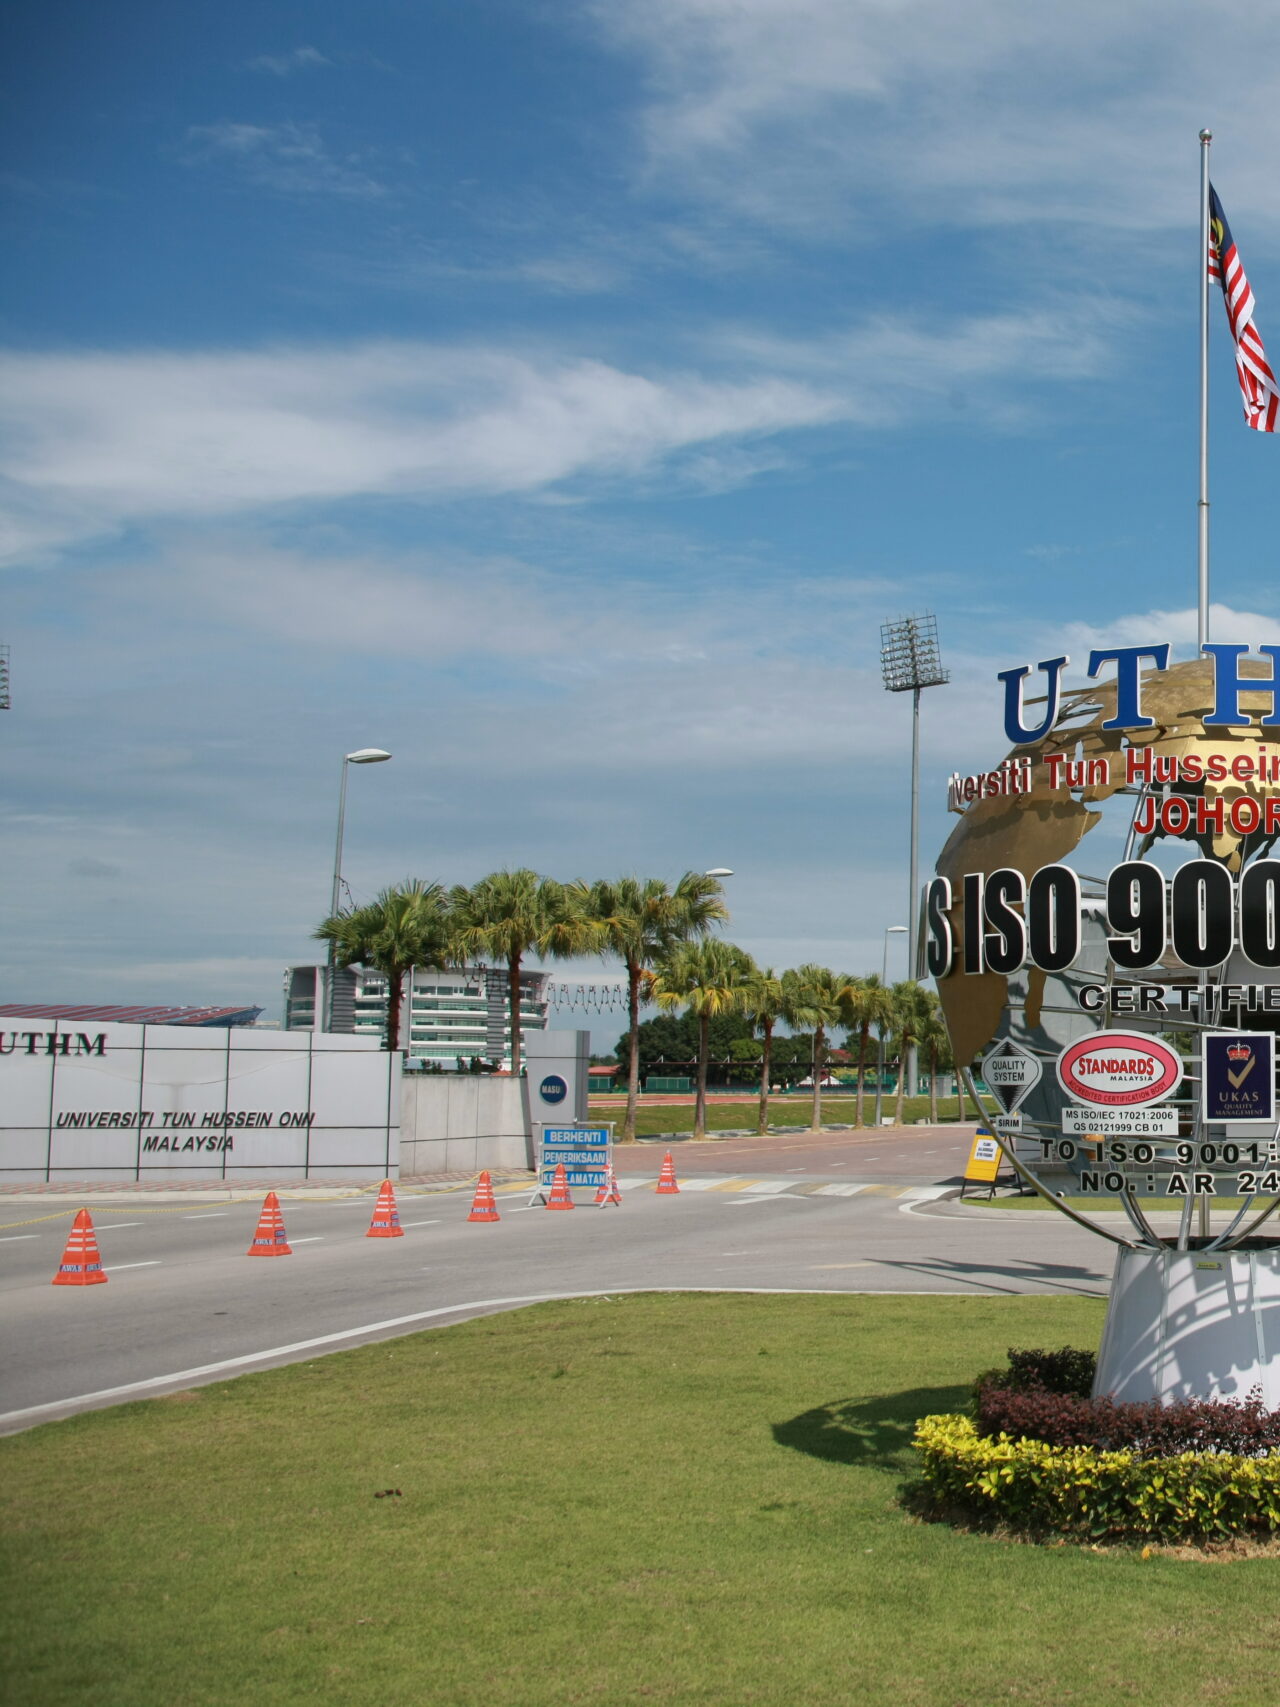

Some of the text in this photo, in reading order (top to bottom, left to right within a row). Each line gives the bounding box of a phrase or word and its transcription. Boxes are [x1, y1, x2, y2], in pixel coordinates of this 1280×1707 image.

[1043, 753, 1109, 790] Tun
[964, 864, 1081, 975] ISO
[0, 1032, 107, 1056] UTHM
[992, 1060, 1026, 1070] QUALITY
[1078, 1057, 1154, 1076] STANDARDS
[993, 1071, 1025, 1082] SYSTEM
[1068, 1080, 1167, 1102] ACCREDITED CERTIFICATION BODY
[1219, 1091, 1260, 1102] UKAS
[56, 1111, 316, 1127] UNIVERSITI TUN HUSSEIN ONN
[1065, 1110, 1173, 1119] MS ISO/IEC 17021:2006
[998, 1119, 1020, 1128] SIRIM
[1073, 1122, 1163, 1131] QS 02121999 CB 01
[143, 1135, 234, 1152] MALAYSIA
[550, 1131, 601, 1142] BERHENTI
[544, 1151, 606, 1163] PEMERIKSAAN
[1040, 1138, 1077, 1162] TO
[1095, 1142, 1155, 1165] ISO
[1166, 1172, 1216, 1195] AR
